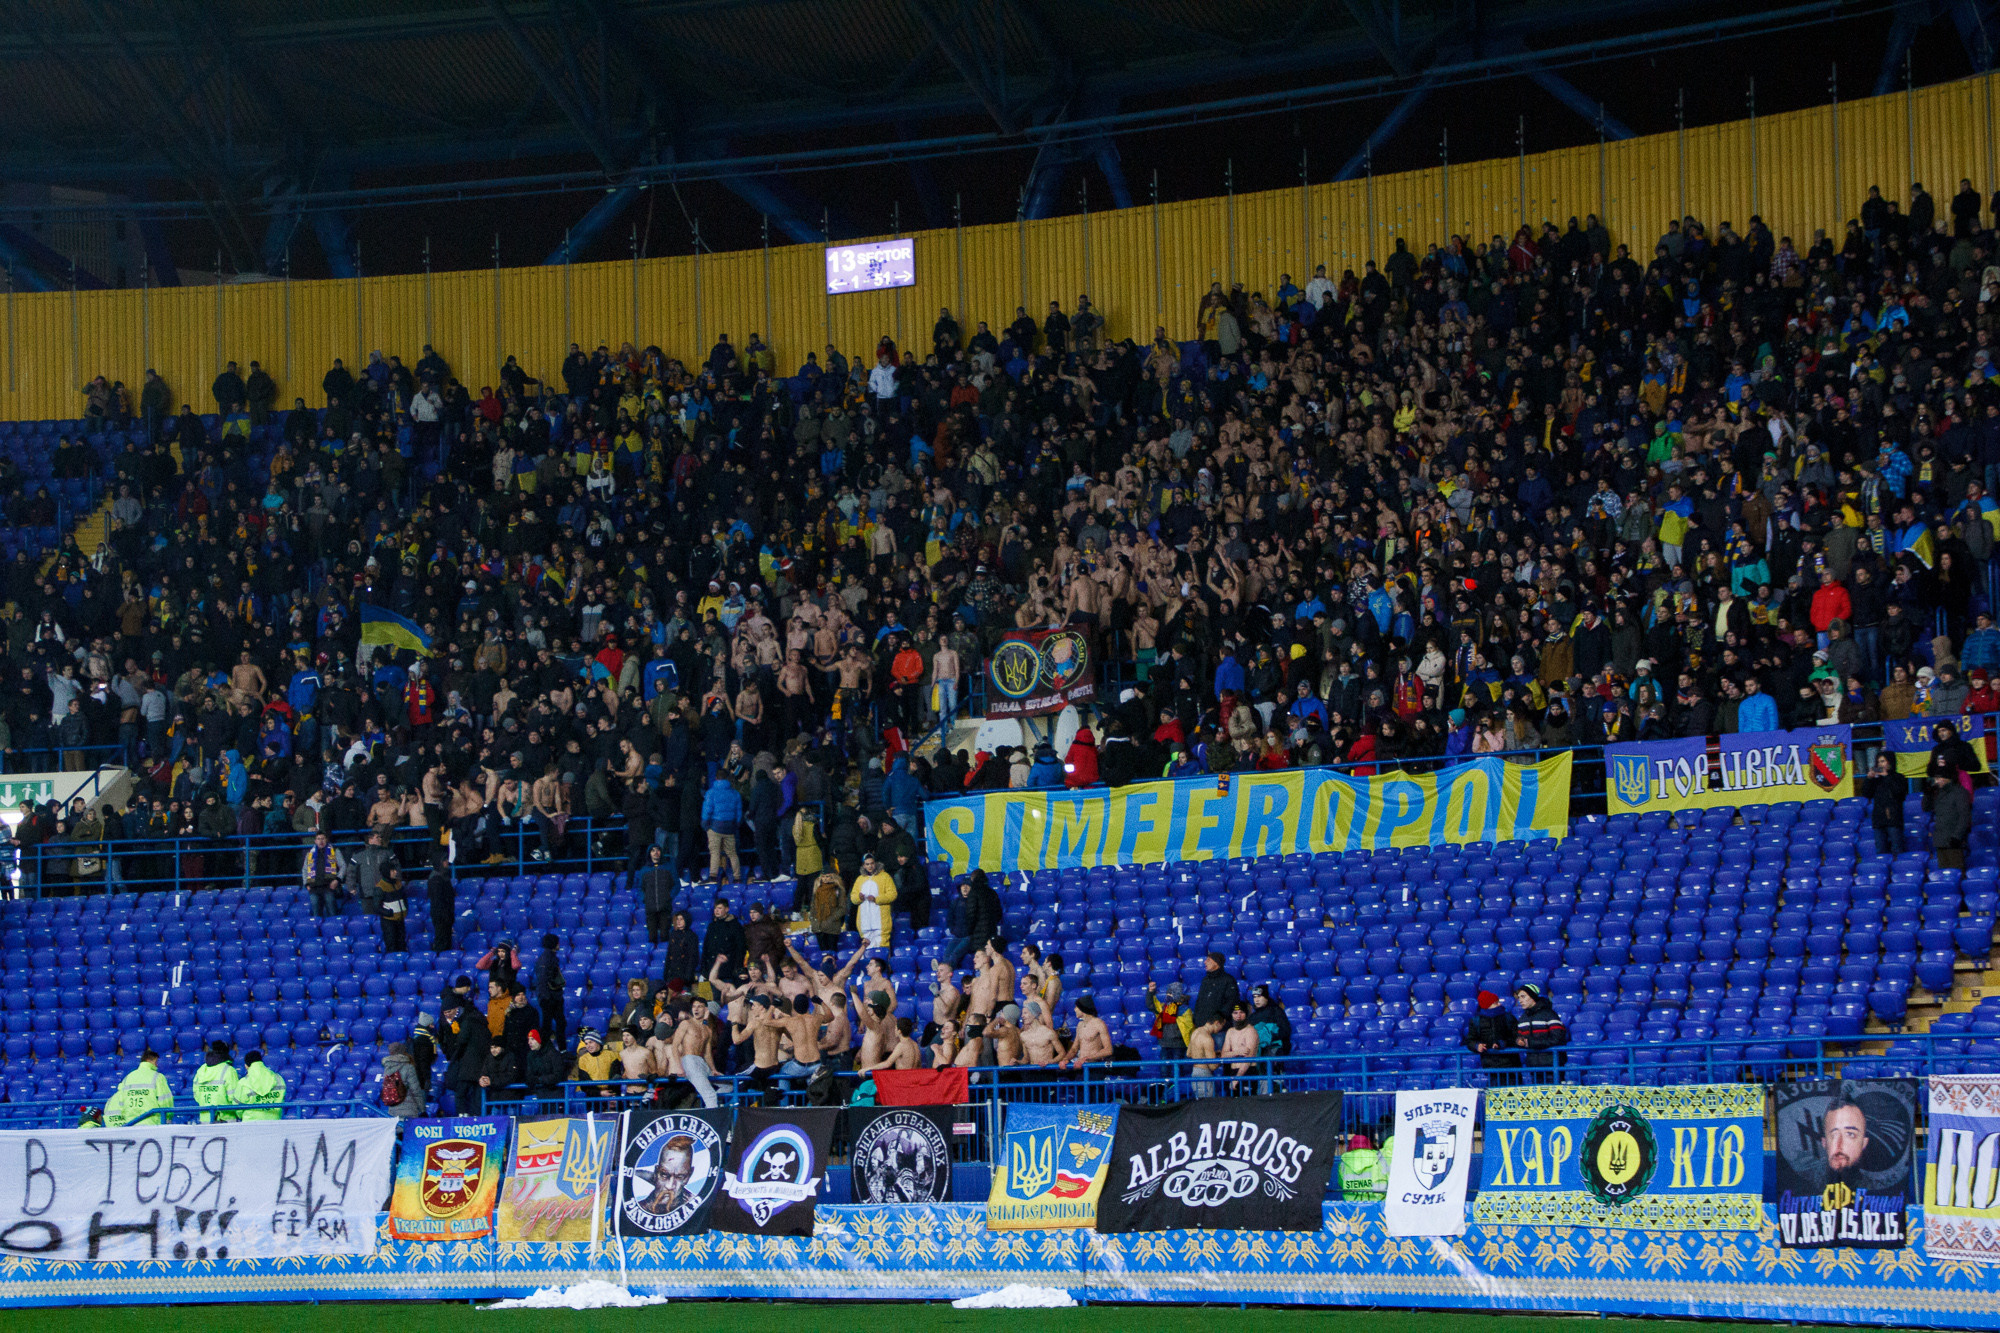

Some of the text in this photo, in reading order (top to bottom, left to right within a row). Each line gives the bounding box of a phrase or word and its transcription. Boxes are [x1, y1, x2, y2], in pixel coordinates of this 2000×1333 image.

[828, 247, 911, 272] 13 SECTOR
[851, 275, 859, 289] 1
[873, 271, 891, 286] 51
[1902, 715, 1972, 744] ХАІВ
[932, 768, 1550, 880] SIMFEROPOL
[129, 1097, 144, 1108] 315
[1403, 1101, 1469, 1122] УЛЬТРАС
[108, 1114, 126, 1122] STEWA
[635, 1116, 718, 1150] GRAD CREW
[857, 1117, 893, 1168] БРИГАДА
[1126, 1120, 1313, 1190] ALBATROSS
[21, 1138, 56, 1216] В
[1345, 1179, 1373, 1190] STEWAR
[440, 1192, 456, 1204] 92
[624, 1196, 703, 1230] PAVLOGRAD
